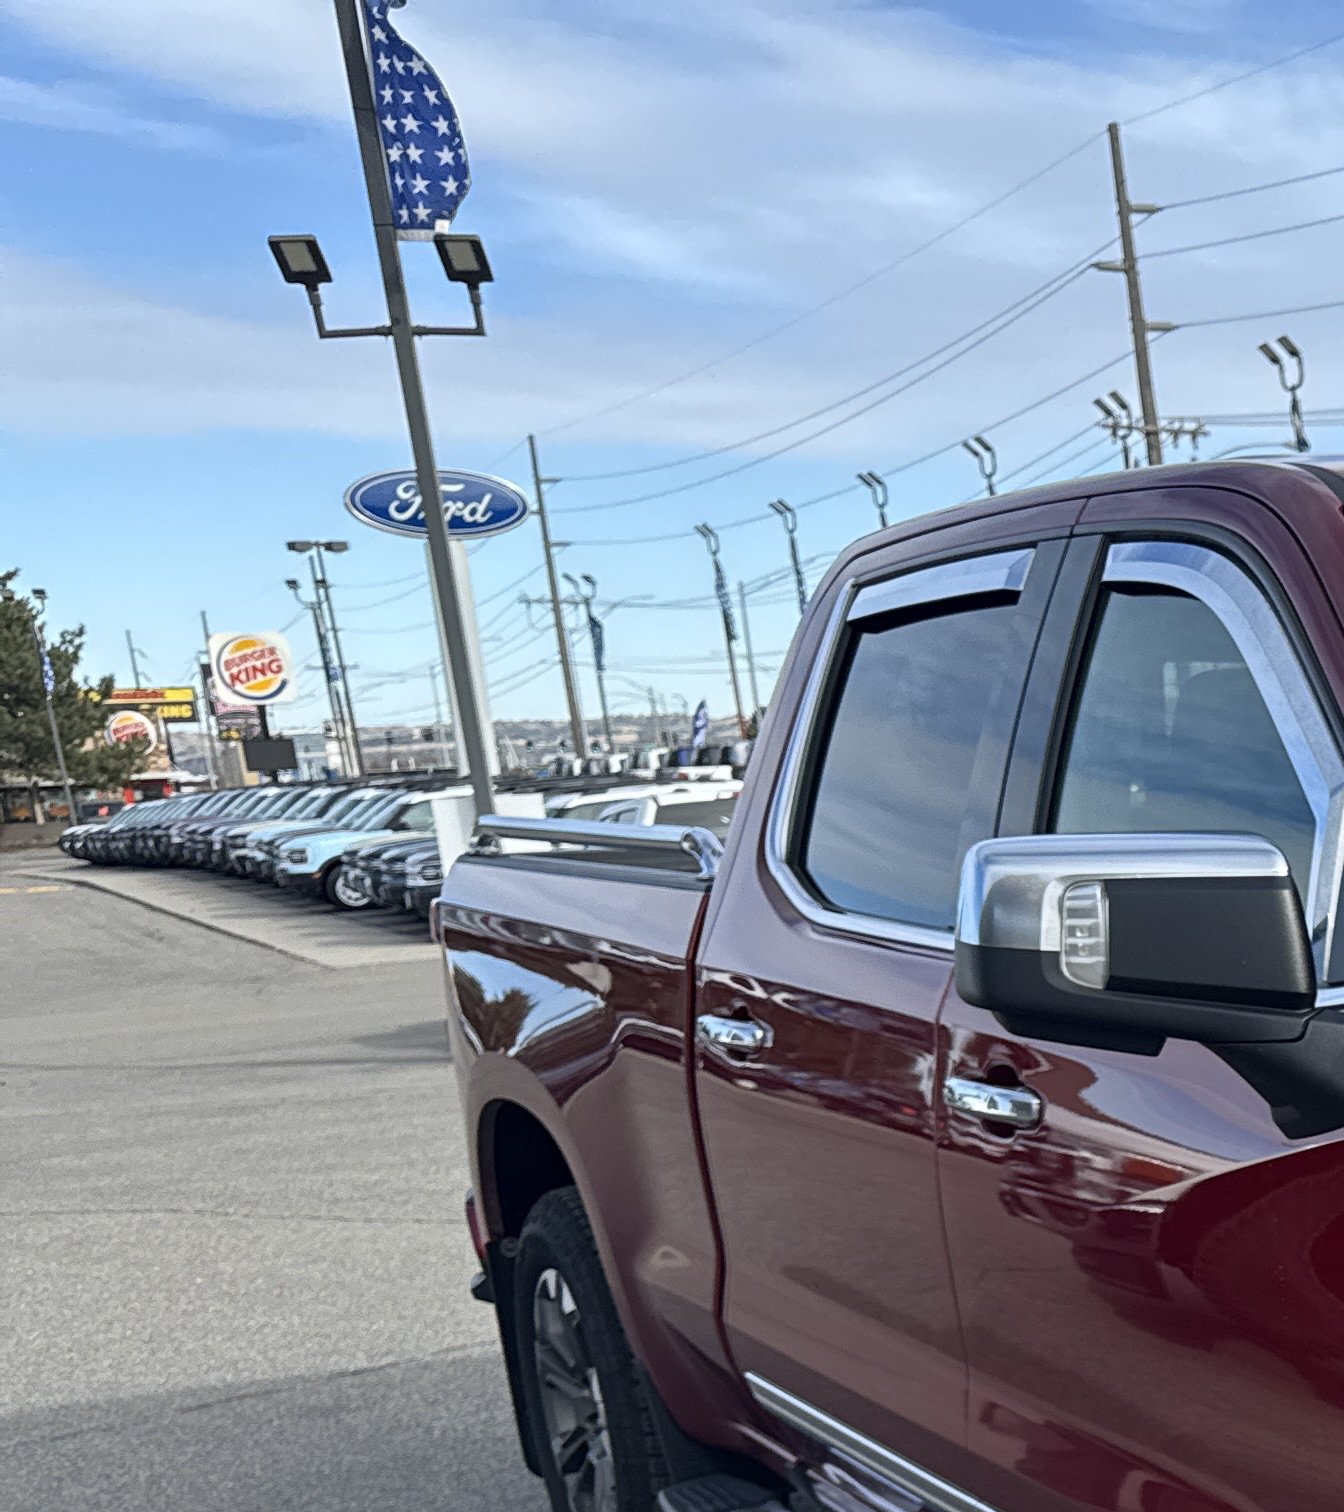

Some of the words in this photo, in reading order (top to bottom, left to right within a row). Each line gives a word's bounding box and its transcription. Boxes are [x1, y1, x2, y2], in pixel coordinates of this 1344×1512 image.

[388, 480, 494, 523] Frd
[223, 646, 279, 673] BURGER
[228, 658, 283, 688] KING
